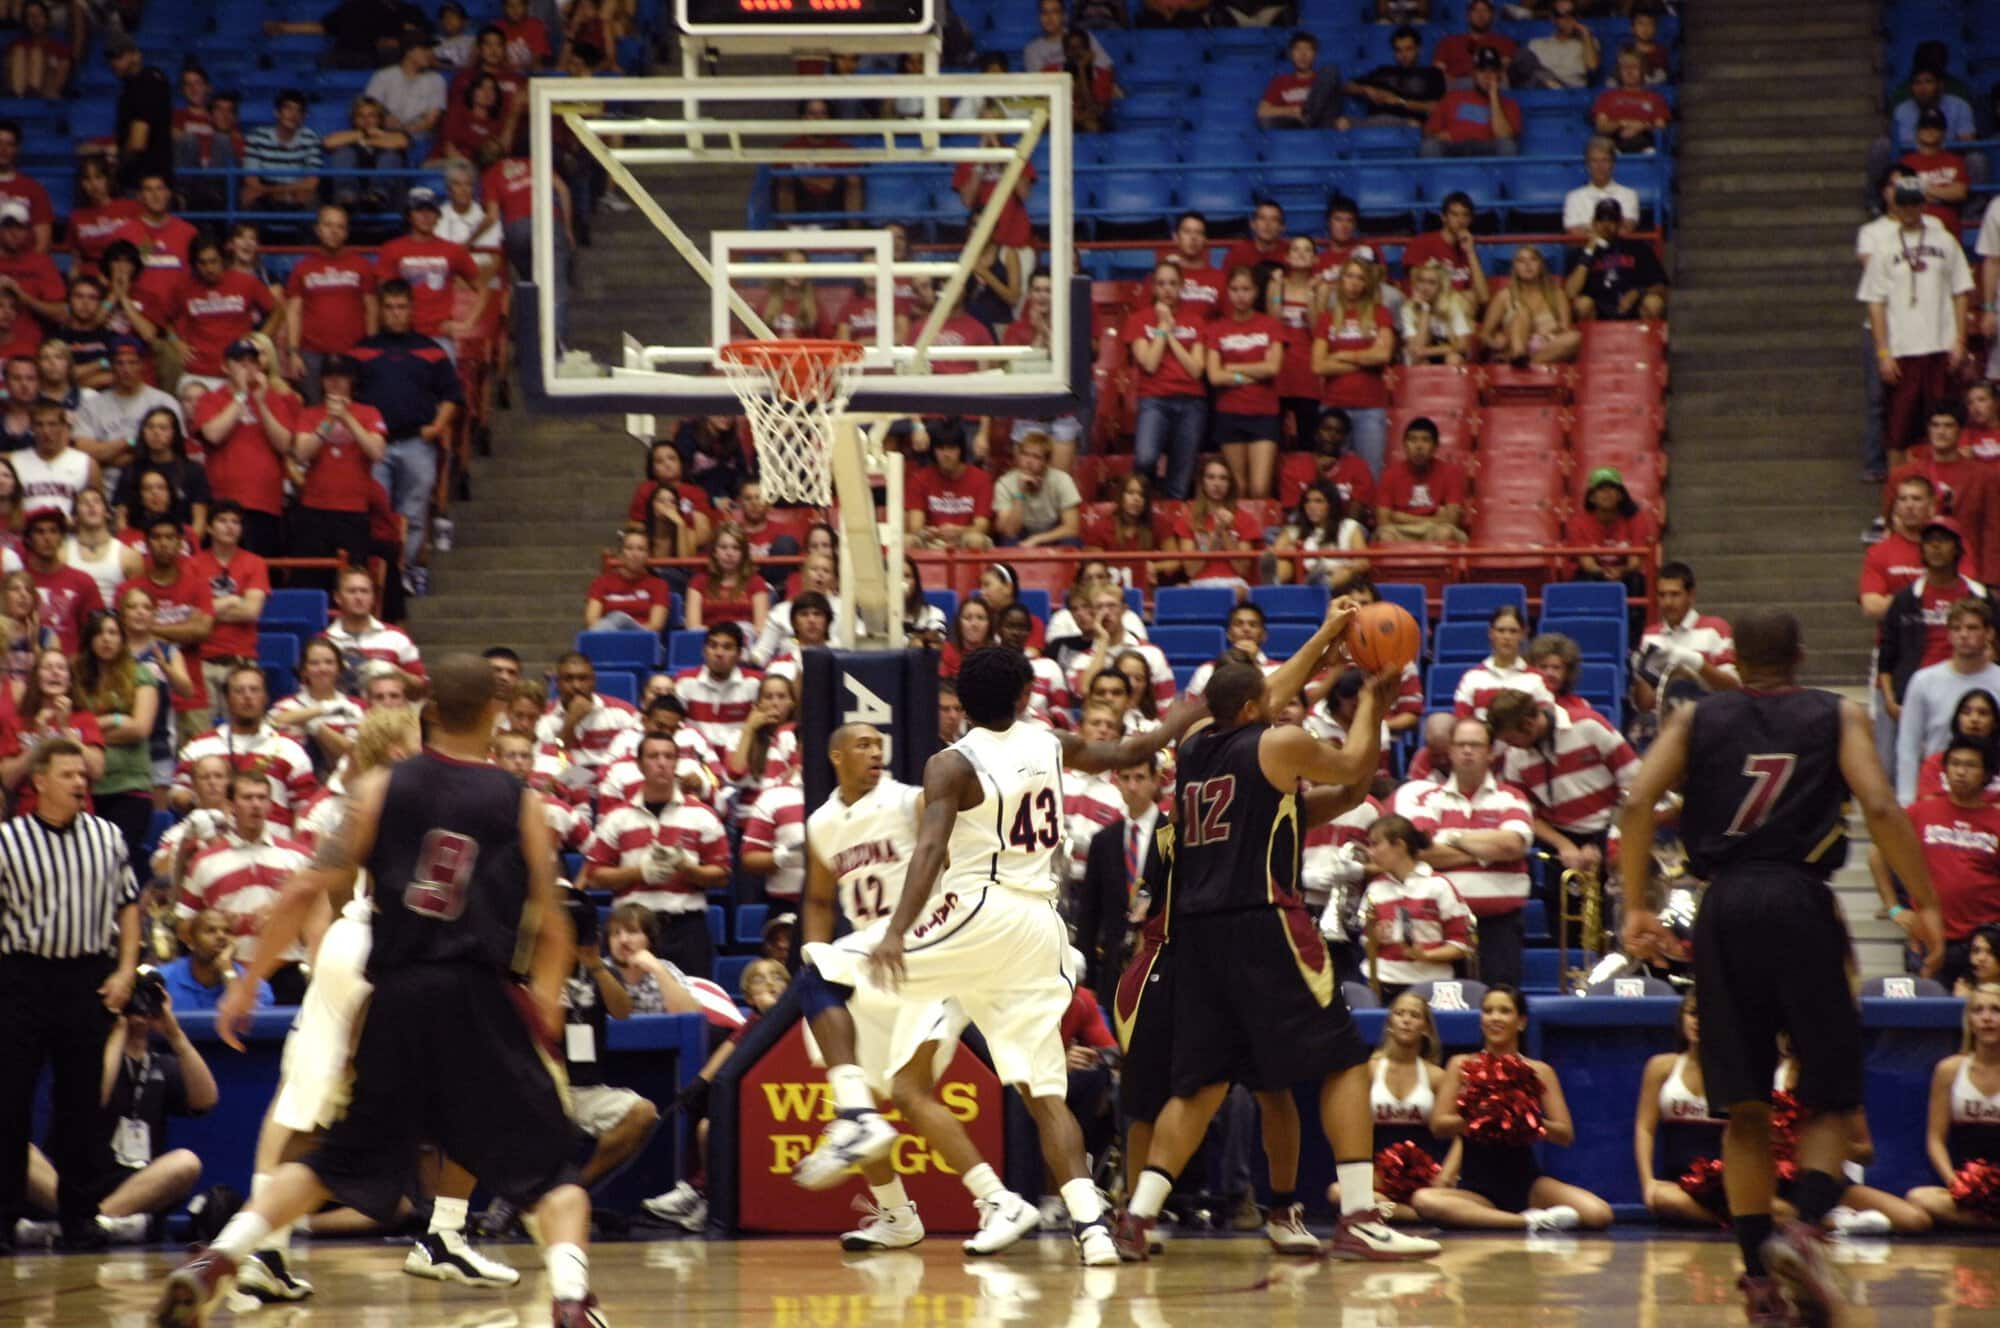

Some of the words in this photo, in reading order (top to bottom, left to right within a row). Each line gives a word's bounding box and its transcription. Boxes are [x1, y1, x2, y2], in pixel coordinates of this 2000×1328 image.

[1009, 787, 1059, 853] 43
[1182, 774, 1236, 846] 12
[1722, 753, 1798, 836] 7
[854, 874, 890, 917] 12
[914, 892, 958, 938] CATS
